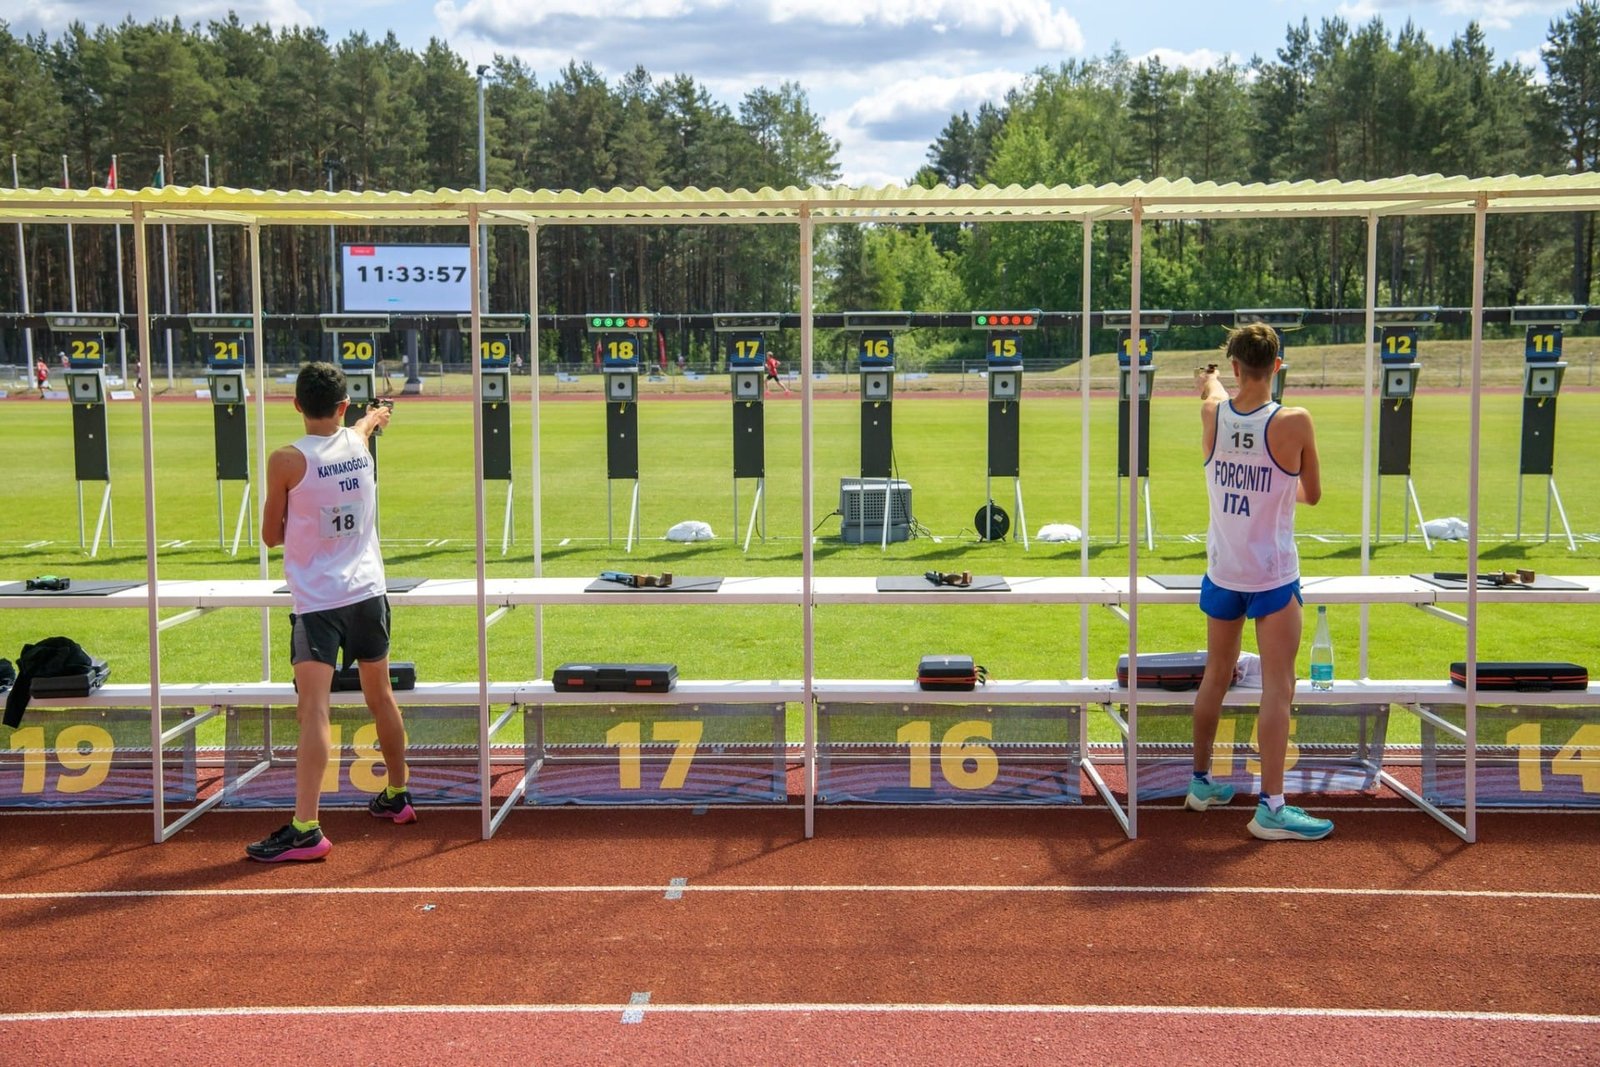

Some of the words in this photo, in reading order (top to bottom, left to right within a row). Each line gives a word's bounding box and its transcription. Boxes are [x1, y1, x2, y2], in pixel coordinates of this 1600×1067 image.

[357, 265, 467, 283] 11:33:57
[71, 341, 100, 359] 22
[214, 341, 238, 360] 21
[342, 341, 372, 360] 20
[481, 341, 506, 360] 19
[608, 341, 634, 360] 18
[735, 341, 760, 359] 17
[864, 339, 889, 358] 16
[992, 339, 1017, 357] 15
[1123, 338, 1148, 356] 14
[1386, 336, 1411, 354] 12
[1532, 334, 1554, 352] 11
[1231, 431, 1254, 449] 15
[338, 477, 360, 492] TÜR
[1214, 460, 1273, 493] FORCINITI
[1223, 492, 1251, 517] ITA
[331, 513, 355, 532] 18
[9, 724, 115, 794] 19
[606, 721, 704, 789] 17
[897, 720, 999, 789] 16
[1506, 723, 1600, 793] 14
